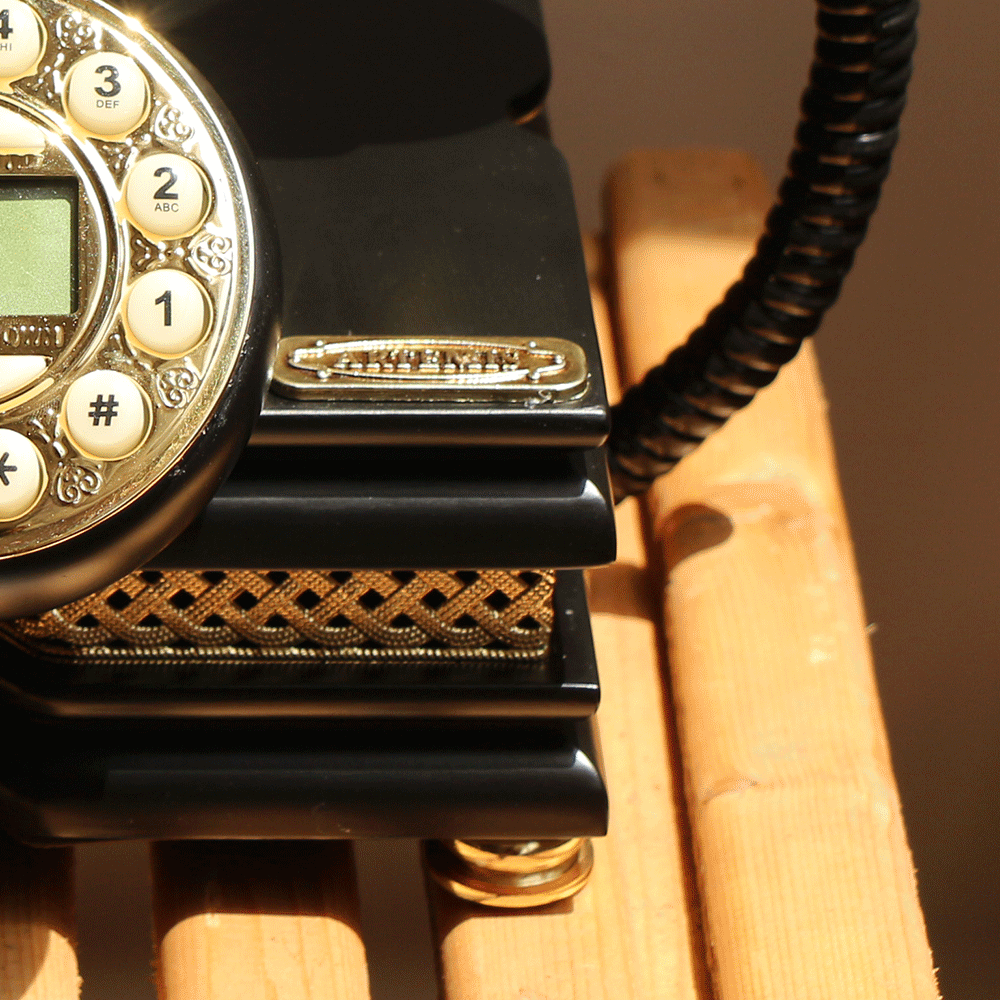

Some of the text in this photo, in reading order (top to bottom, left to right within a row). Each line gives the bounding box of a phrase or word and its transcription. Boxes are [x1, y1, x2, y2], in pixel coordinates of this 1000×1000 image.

[95, 65, 121, 98] 3
[96, 99, 120, 109] DEF
[153, 167, 178, 200] 2
[154, 202, 179, 213] ABC
[155, 290, 172, 327] 1
[88, 394, 119, 427] #
